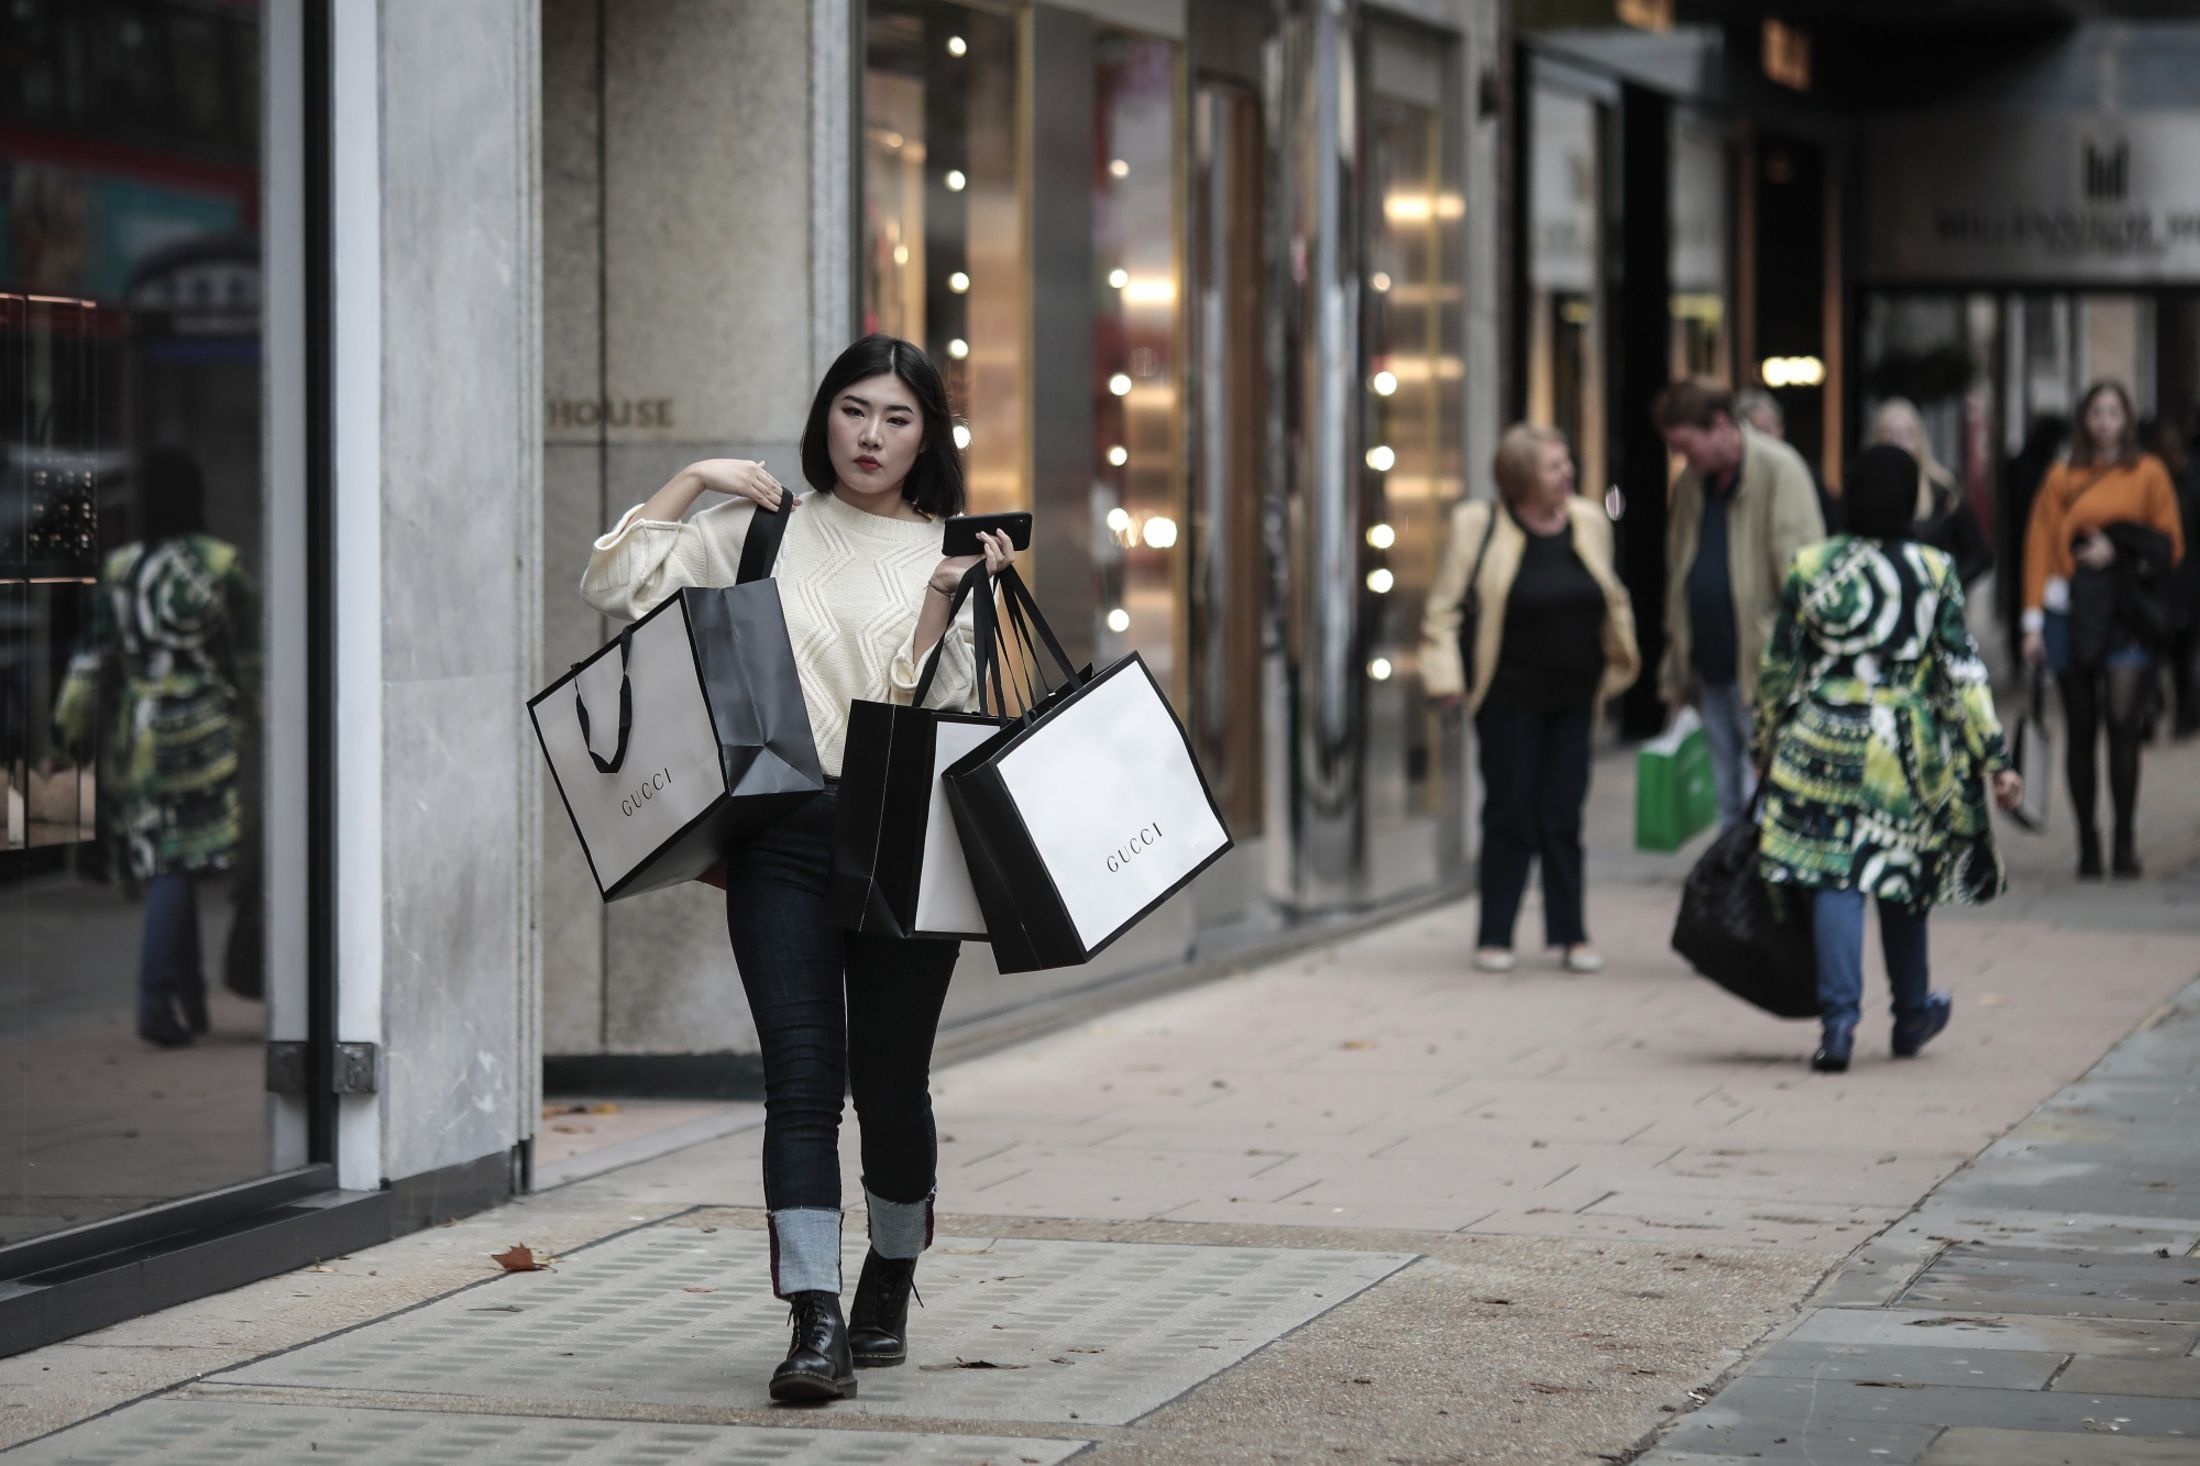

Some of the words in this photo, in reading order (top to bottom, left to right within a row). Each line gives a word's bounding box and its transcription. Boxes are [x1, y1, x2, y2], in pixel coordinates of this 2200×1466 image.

[547, 399, 675, 428] HOUSE
[622, 768, 672, 817] GUCCI
[1107, 822, 1162, 873] GUCCI
